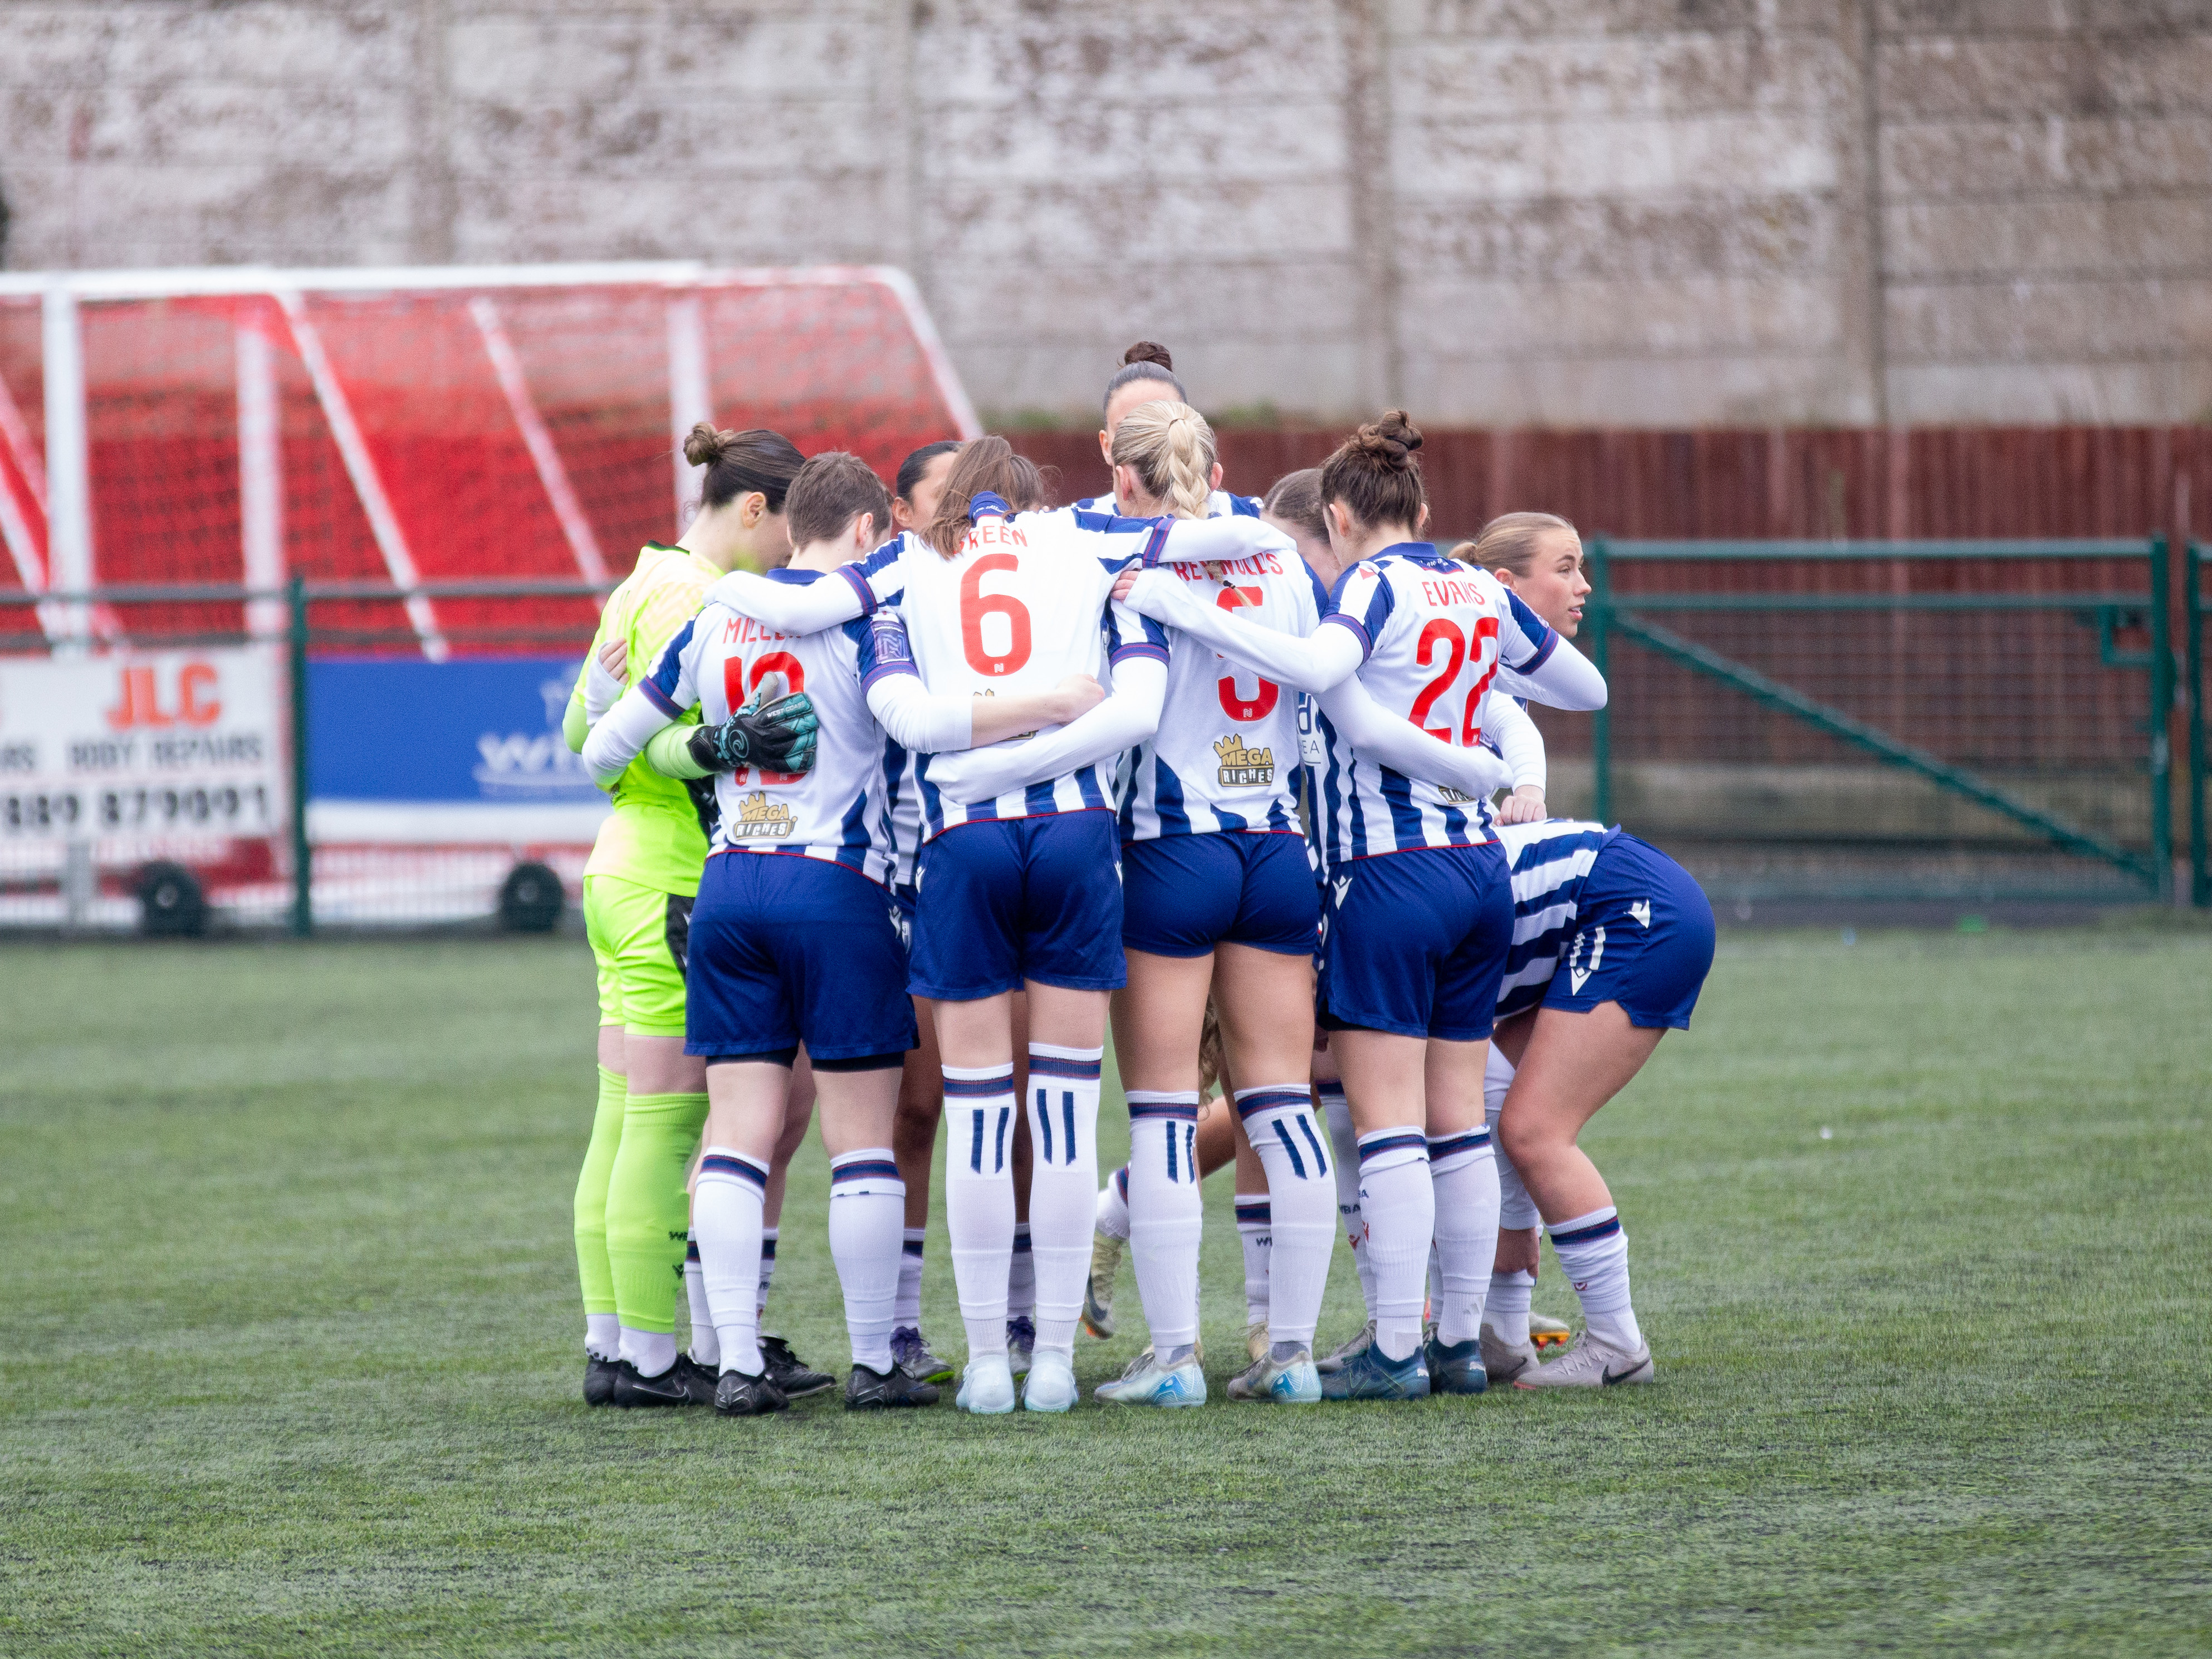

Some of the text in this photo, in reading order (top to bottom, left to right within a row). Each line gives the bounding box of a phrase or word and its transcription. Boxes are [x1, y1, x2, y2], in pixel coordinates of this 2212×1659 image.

[1421, 580, 1485, 606] EVANS
[960, 553, 1032, 677] 6
[723, 616, 801, 644] MILL
[1408, 616, 1499, 747] 22
[107, 663, 221, 730] JLC
[766, 700, 805, 718] WEST COAST
[1221, 747, 1274, 766] MEGA
[1222, 769, 1273, 784] RICHES
[741, 804, 790, 821] MEGA
[736, 823, 787, 836] RICHES
